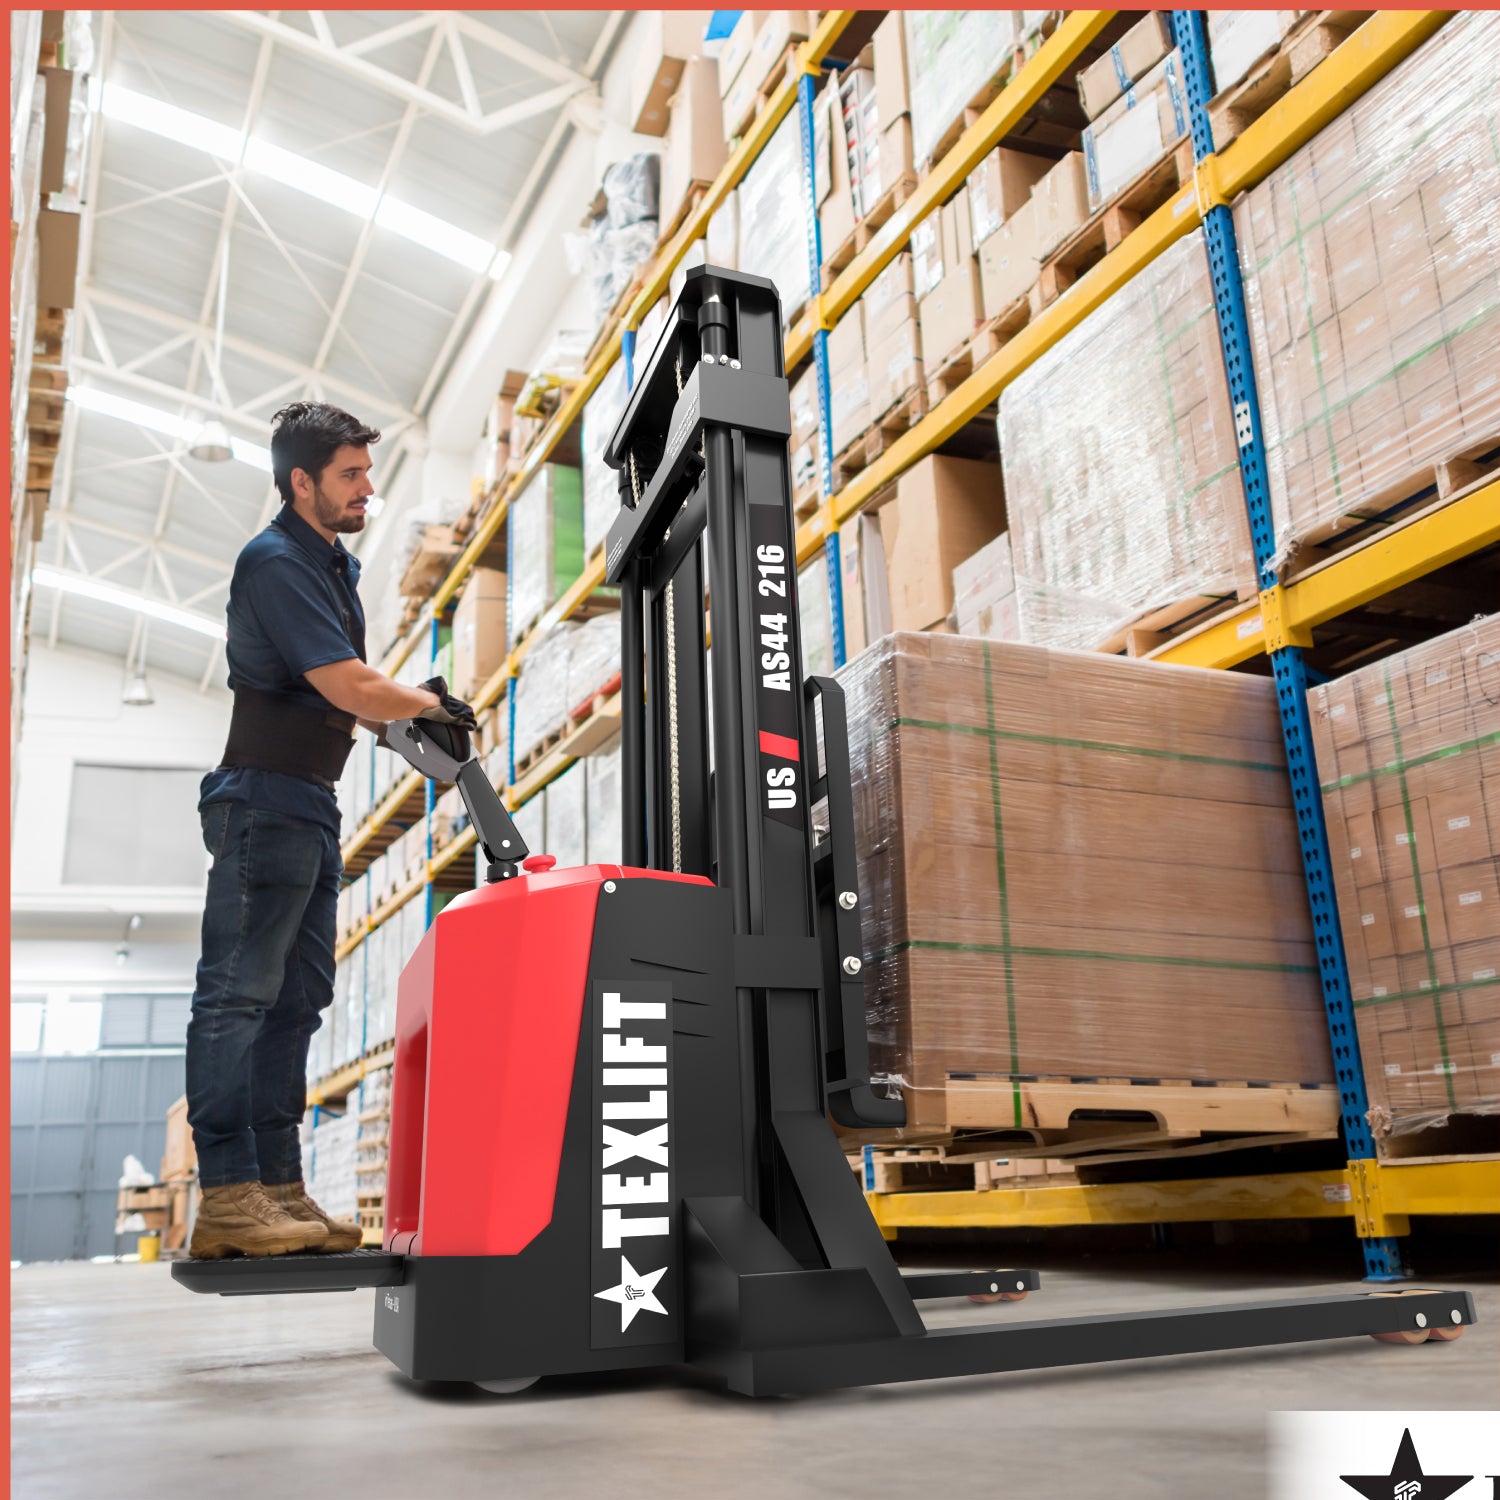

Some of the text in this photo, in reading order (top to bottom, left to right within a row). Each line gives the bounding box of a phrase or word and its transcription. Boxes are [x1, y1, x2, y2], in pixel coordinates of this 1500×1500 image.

[756, 544, 797, 809] US AS44 216
[602, 992, 669, 1249] TEXLIFT
